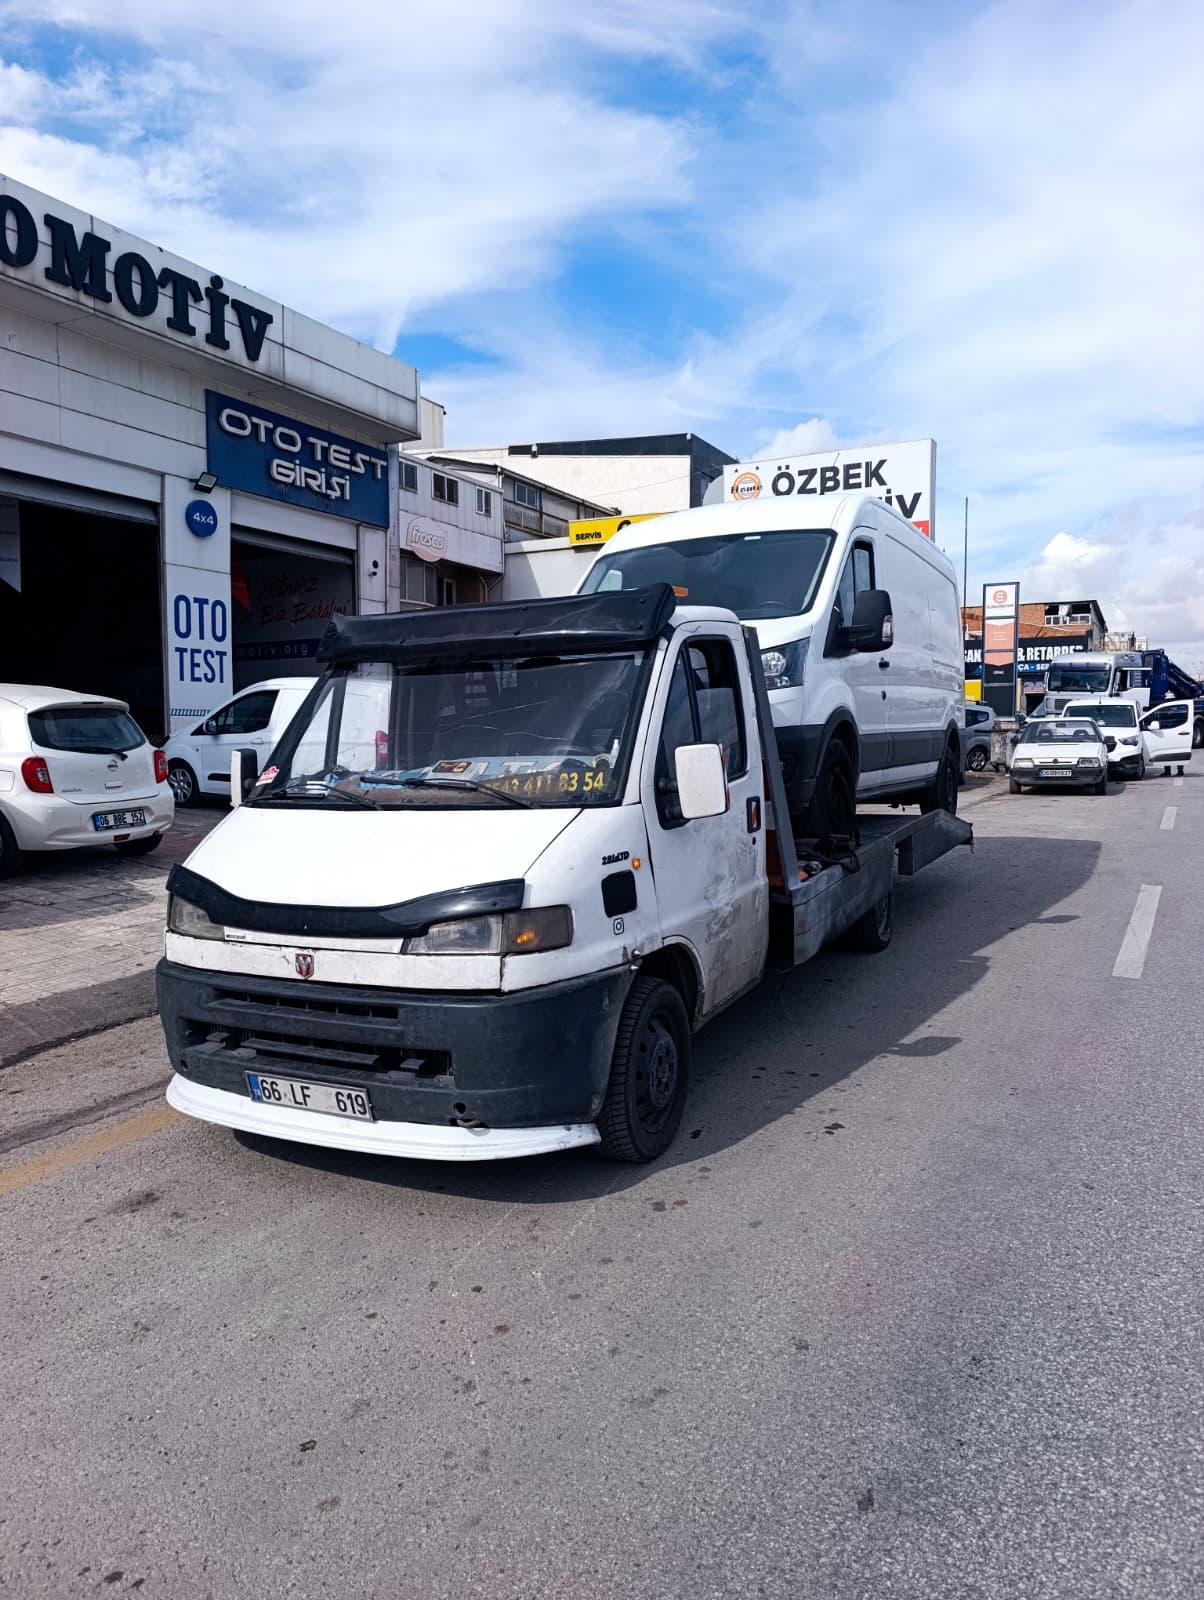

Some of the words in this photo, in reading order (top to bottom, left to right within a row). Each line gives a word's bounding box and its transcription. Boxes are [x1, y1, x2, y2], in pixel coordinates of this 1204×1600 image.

[0, 194, 273, 362] OMOTİV
[219, 408, 302, 453] OTO
[307, 436, 388, 480] TEST
[270, 458, 350, 500] GİRİŞİ
[771, 459, 888, 496] ÖZBEK
[193, 512, 214, 526] 4x4
[575, 530, 602, 541] SERVİS
[174, 594, 227, 643] OTO
[174, 646, 228, 683] TEST
[583, 771, 604, 792] 54
[100, 816, 110, 826] 06
[260, 1079, 282, 1101] 66
[290, 1083, 311, 1106] LF
[335, 1091, 367, 1115] 619
